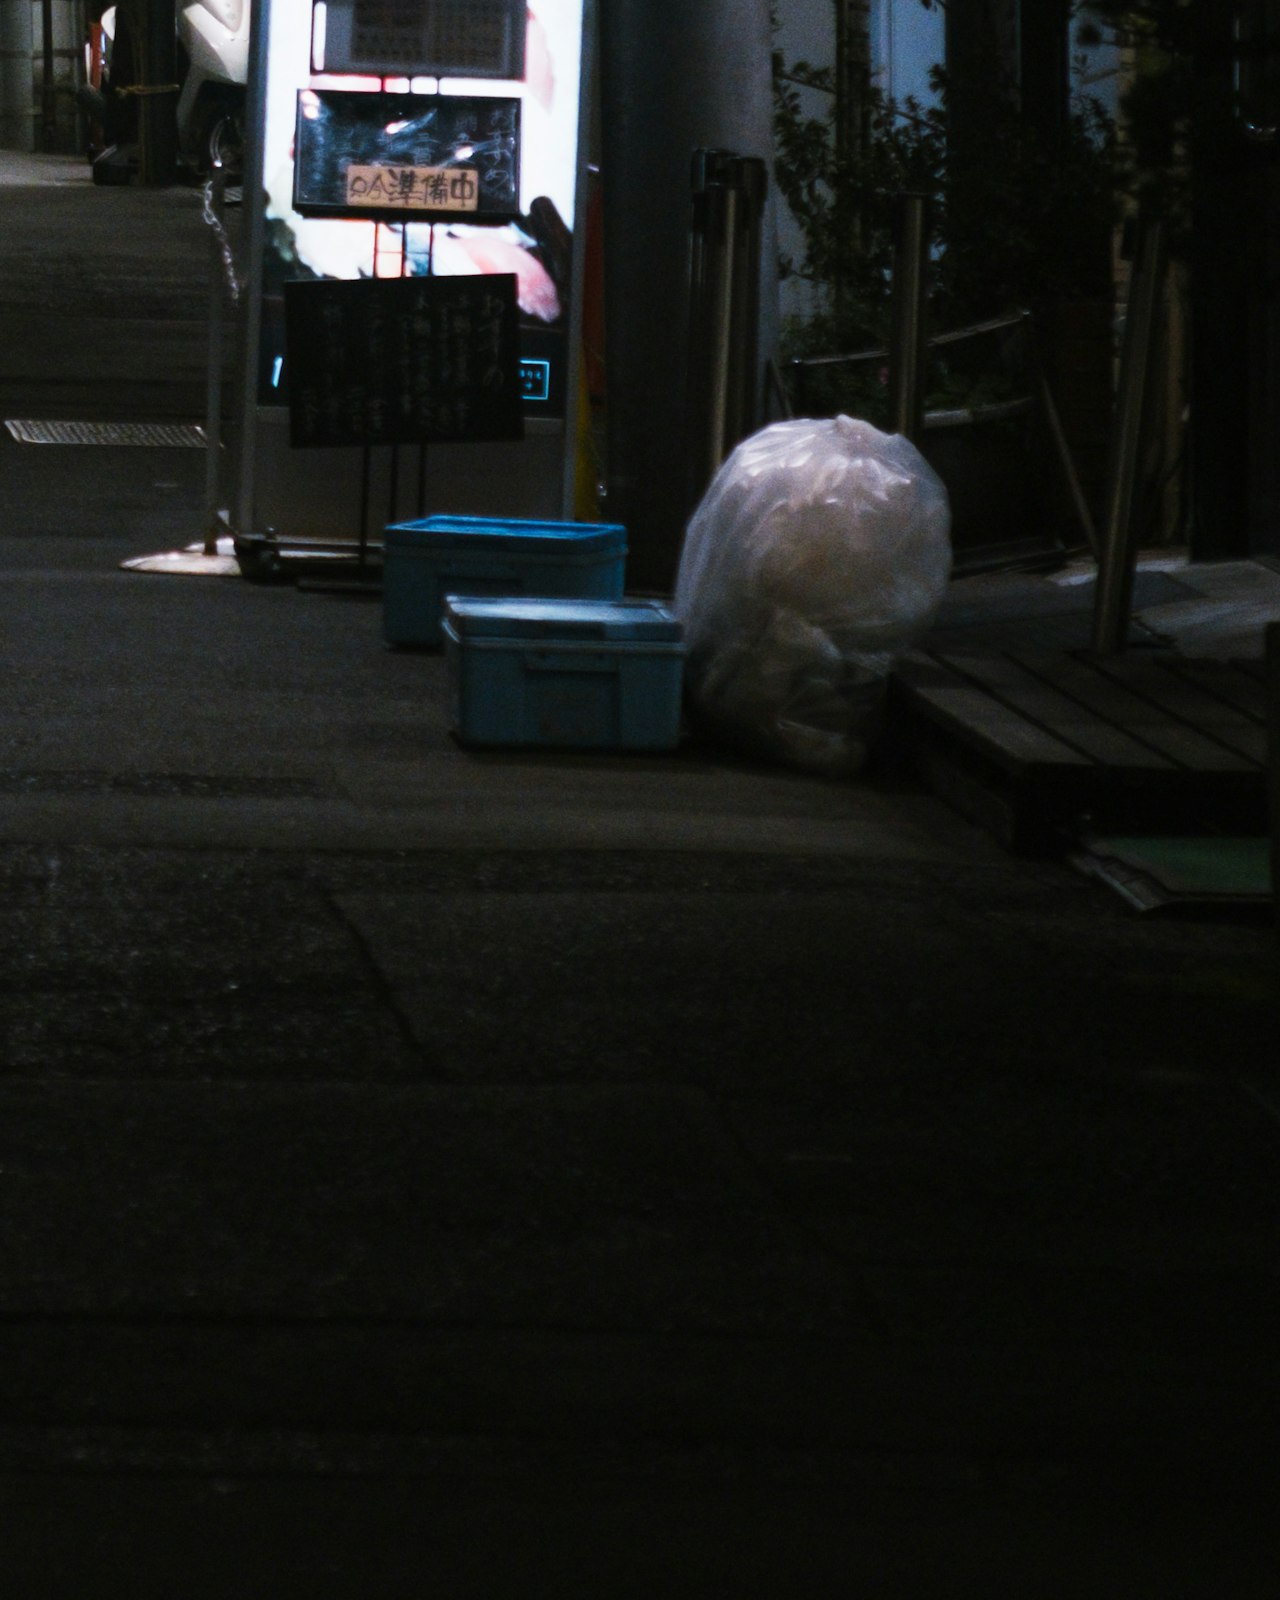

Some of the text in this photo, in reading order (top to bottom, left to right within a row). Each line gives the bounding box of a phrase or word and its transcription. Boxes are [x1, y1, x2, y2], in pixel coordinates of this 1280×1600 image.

[350, 168, 475, 207] 只今準備中
